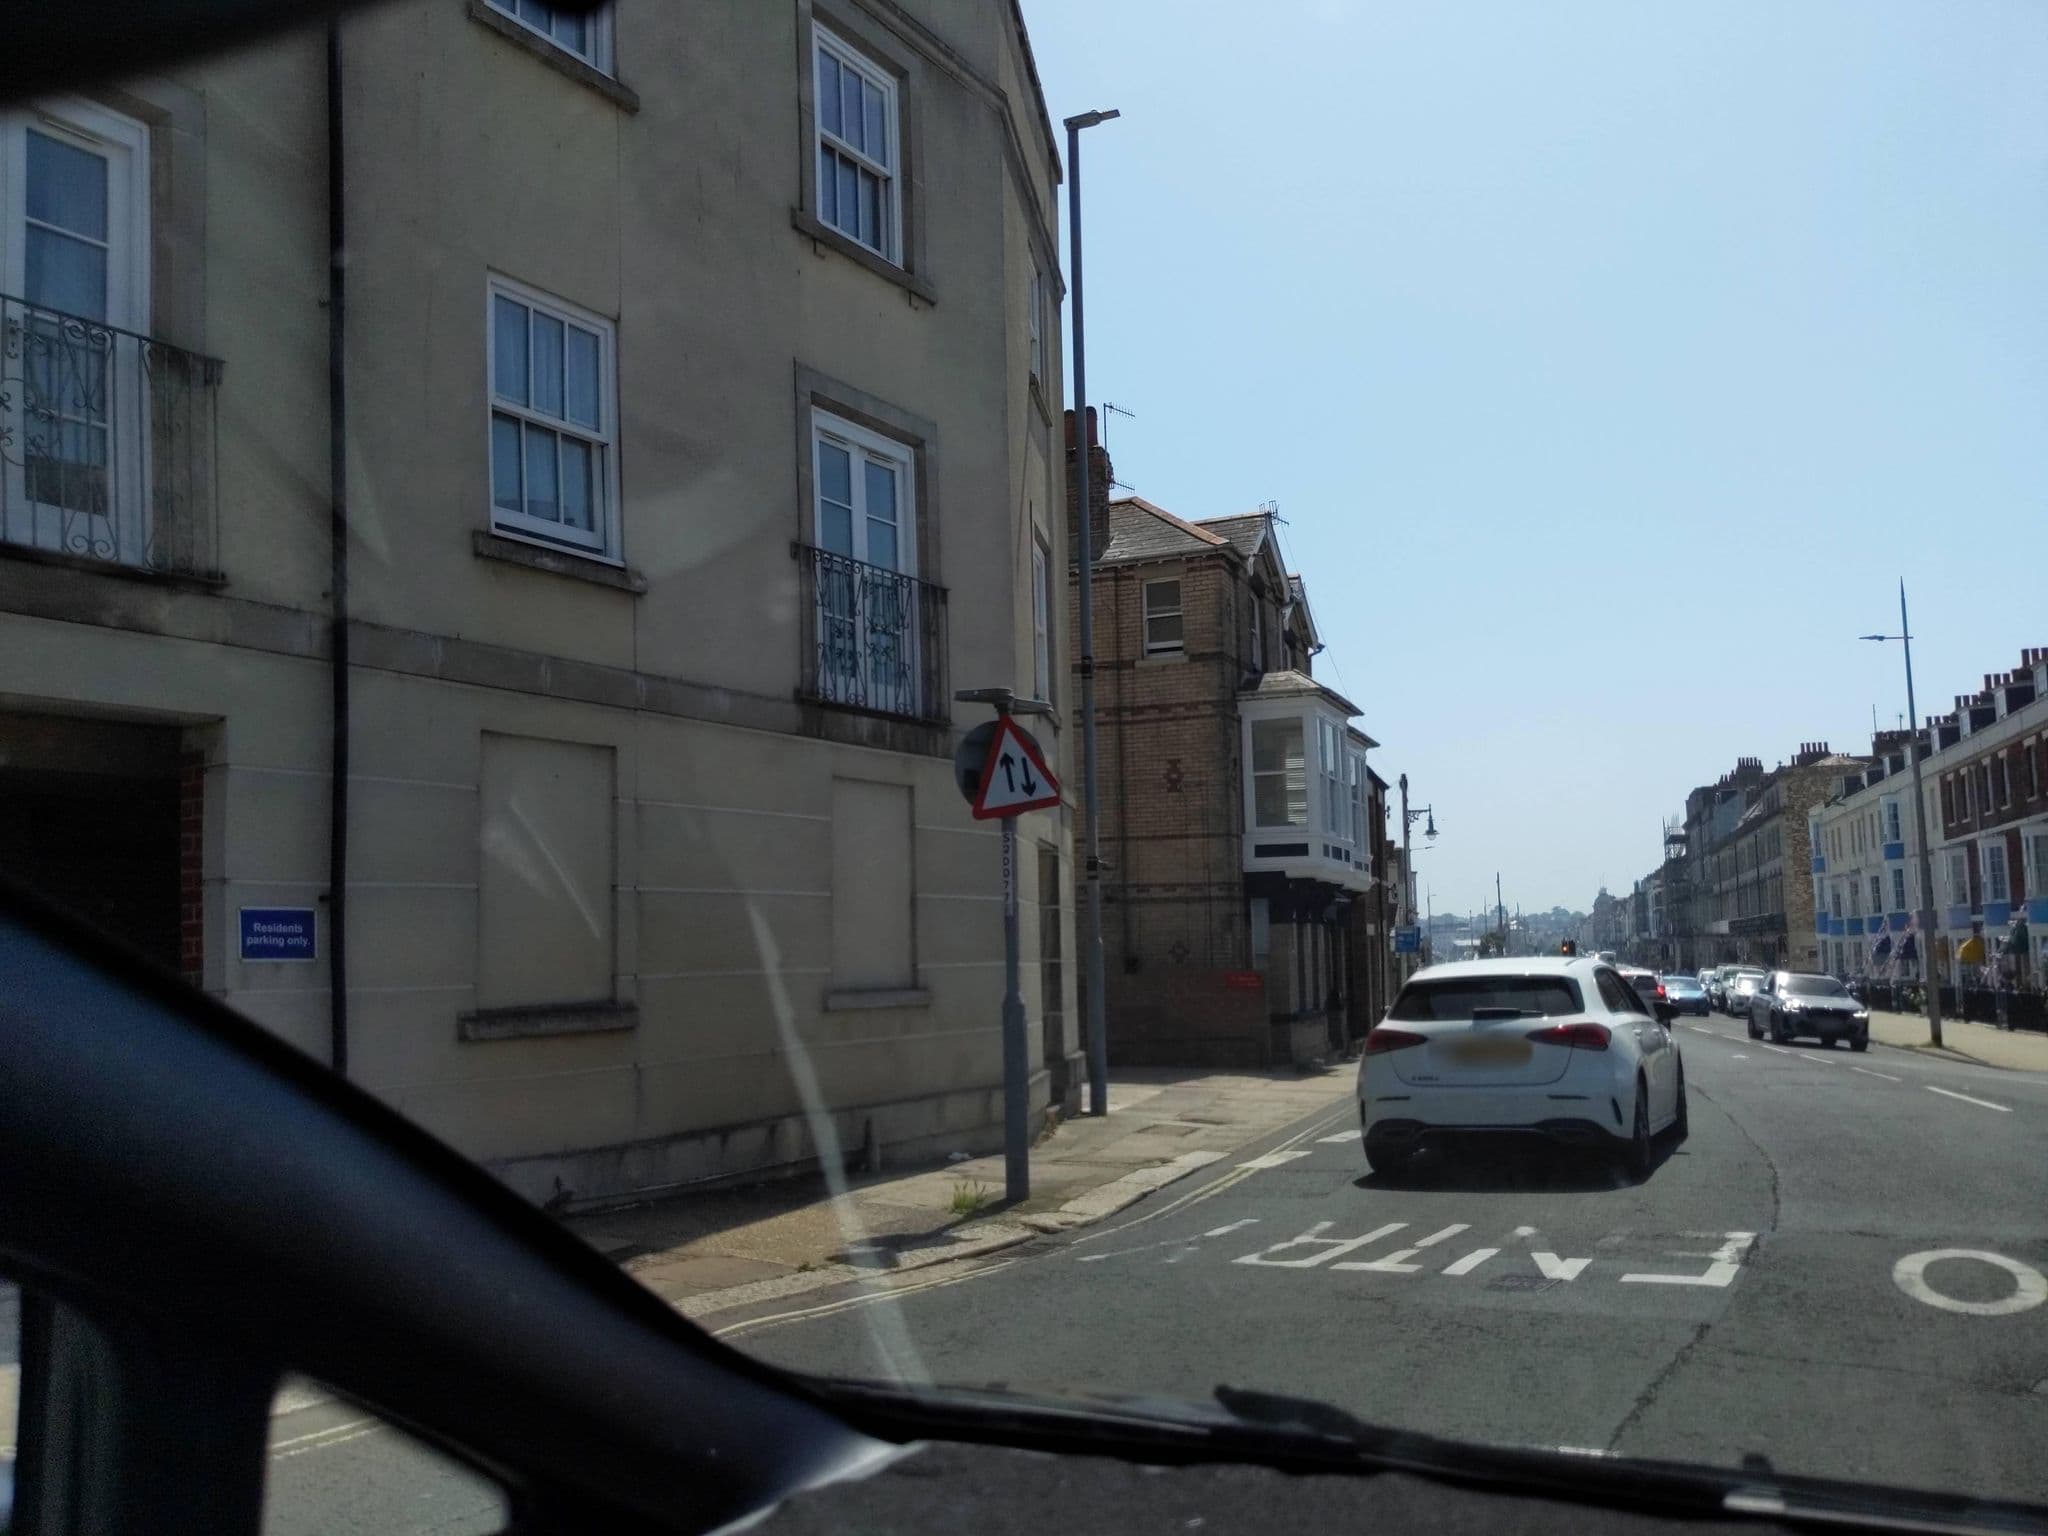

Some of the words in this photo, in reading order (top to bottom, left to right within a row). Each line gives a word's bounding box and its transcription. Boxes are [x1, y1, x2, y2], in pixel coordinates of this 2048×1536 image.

[253, 922, 303, 933] Residents
[246, 935, 285, 947] parking
[1074, 1217, 1757, 1288] ENTRY
